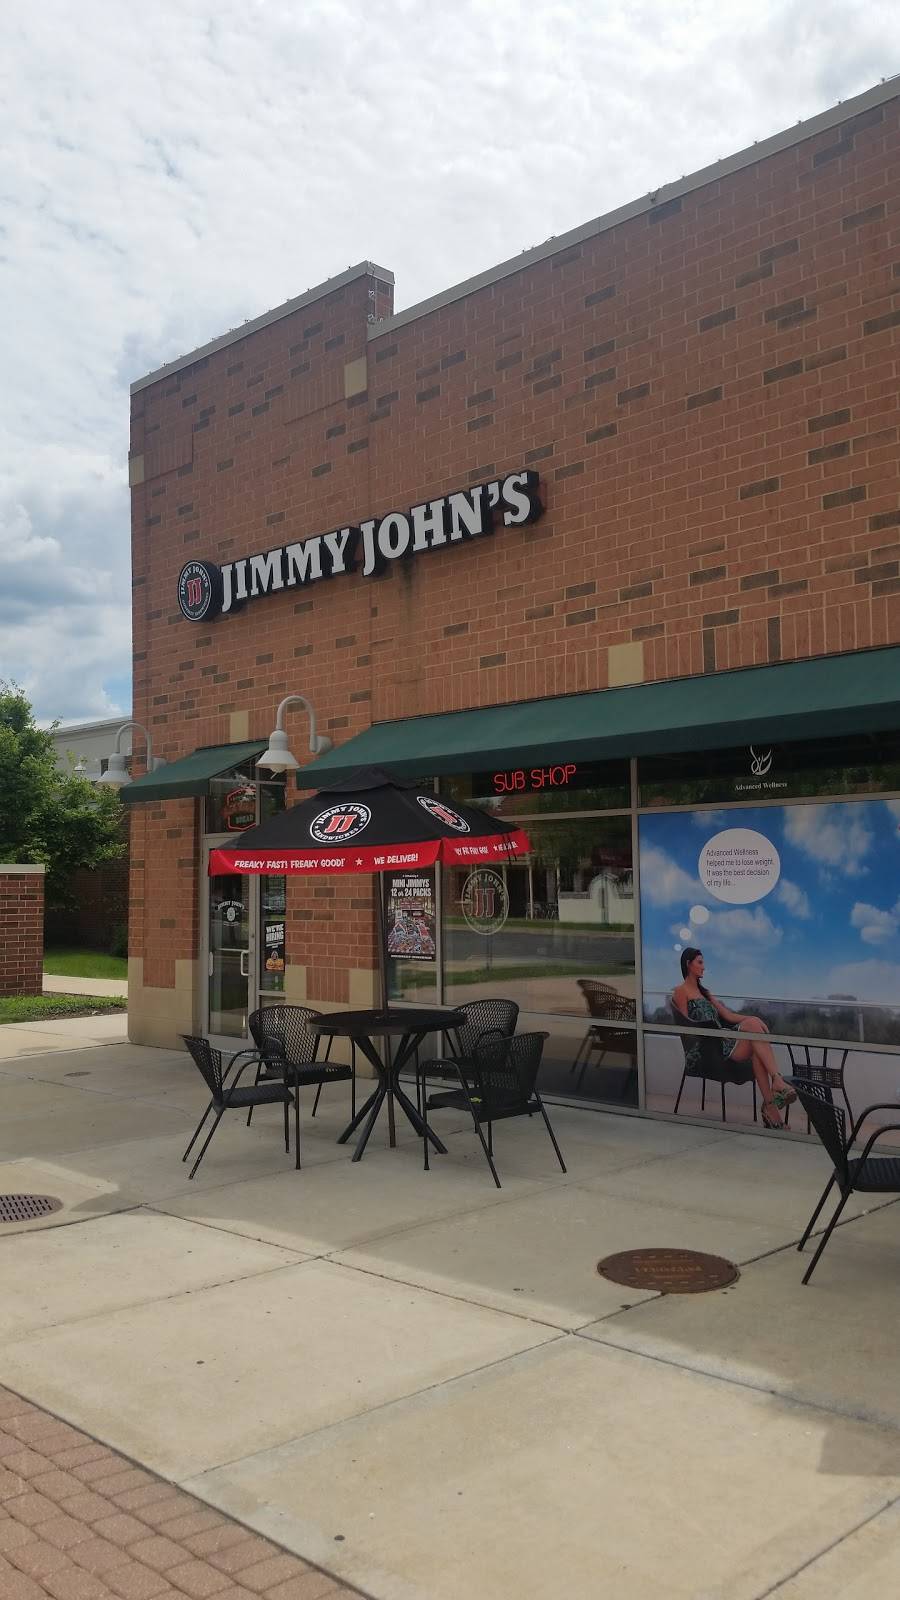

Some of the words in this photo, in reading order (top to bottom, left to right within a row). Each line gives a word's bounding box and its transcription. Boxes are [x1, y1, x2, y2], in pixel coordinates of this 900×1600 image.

[221, 528, 350, 612] JIMMY
[360, 472, 531, 577] JOHN'S
[494, 771, 526, 792] SUB
[530, 764, 577, 788] SHOP
[735, 782, 762, 791] Advanced
[762, 781, 788, 789] Wellness
[316, 806, 348, 825] JIMMY
[324, 814, 358, 833] JJ
[706, 849, 733, 857] Advanced
[733, 848, 759, 856] Wellness
[234, 860, 265, 870] FREAKY
[266, 860, 288, 869] FAST!
[290, 859, 319, 869] FREAKY
[320, 858, 346, 868] GOOD!
[373, 855, 385, 865] WE
[386, 853, 419, 864] DELIVER!
[706, 859, 725, 867] helped
[392, 879, 406, 888] MINI
[406, 878, 430, 888] JIMMYS
[706, 879, 713, 887] of
[713, 880, 722, 888] my
[391, 887, 398, 897] 12
[404, 887, 412, 897] 24
[412, 887, 432, 897] PACKS
